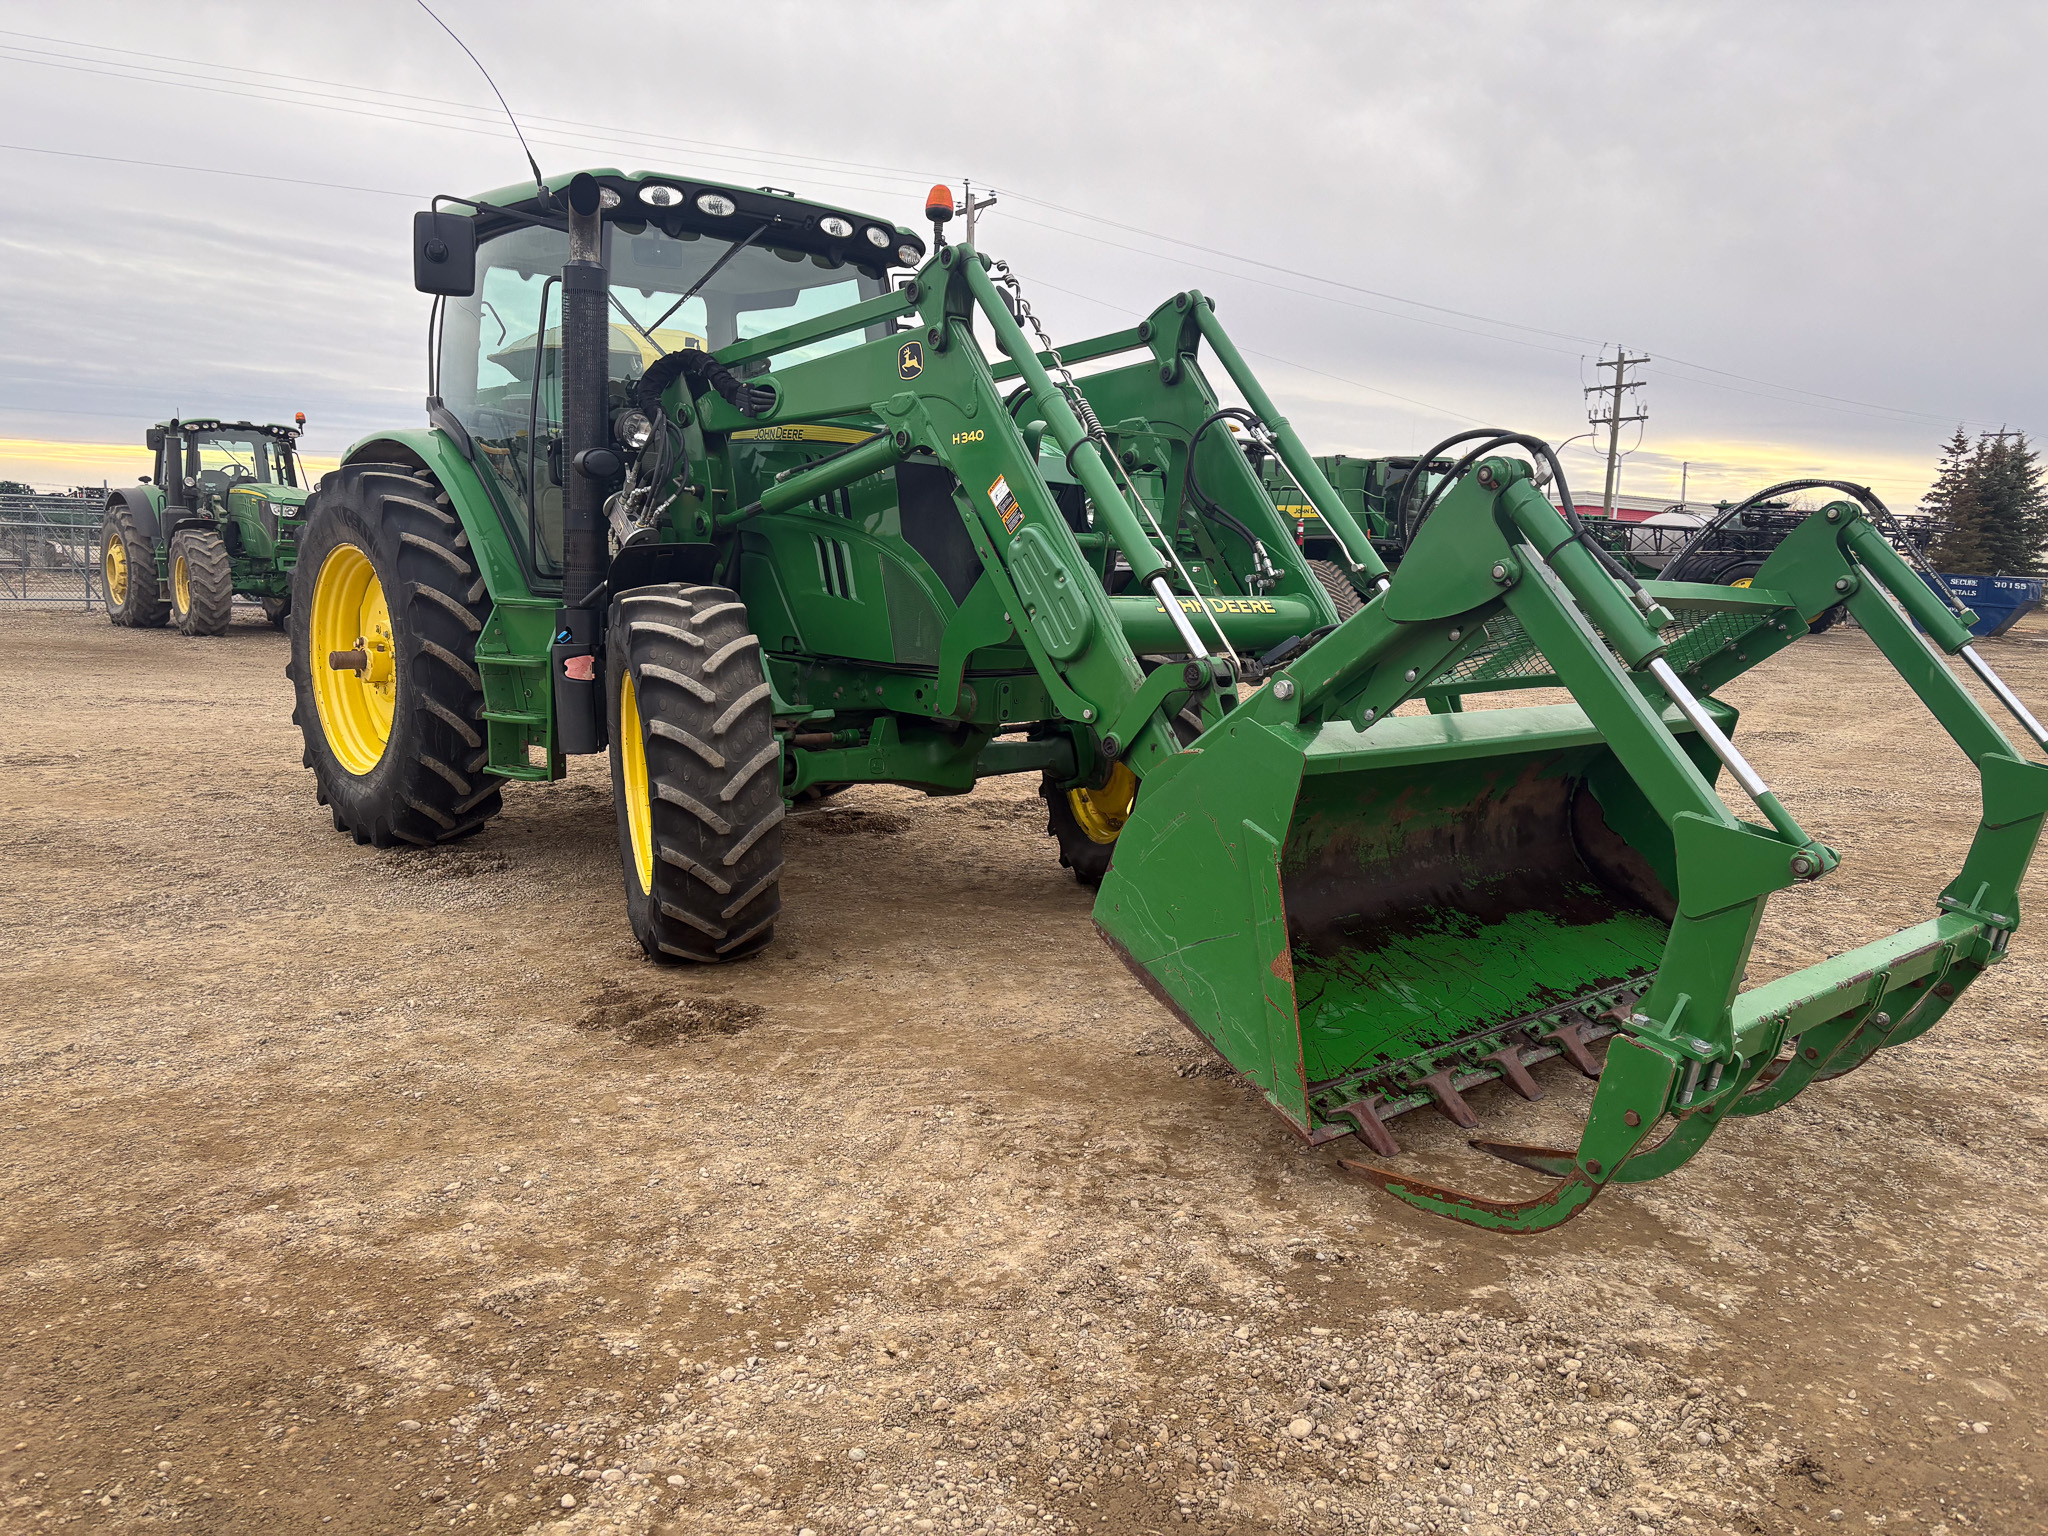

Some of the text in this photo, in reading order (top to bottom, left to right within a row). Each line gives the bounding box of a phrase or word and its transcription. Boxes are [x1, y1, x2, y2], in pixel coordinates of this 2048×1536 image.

[754, 427, 804, 440] JOHN DEERE
[952, 429, 985, 445] H340
[1950, 578, 1978, 587] SECURE
[1994, 581, 2027, 590] 30155
[1206, 598, 1276, 614] DEERE
